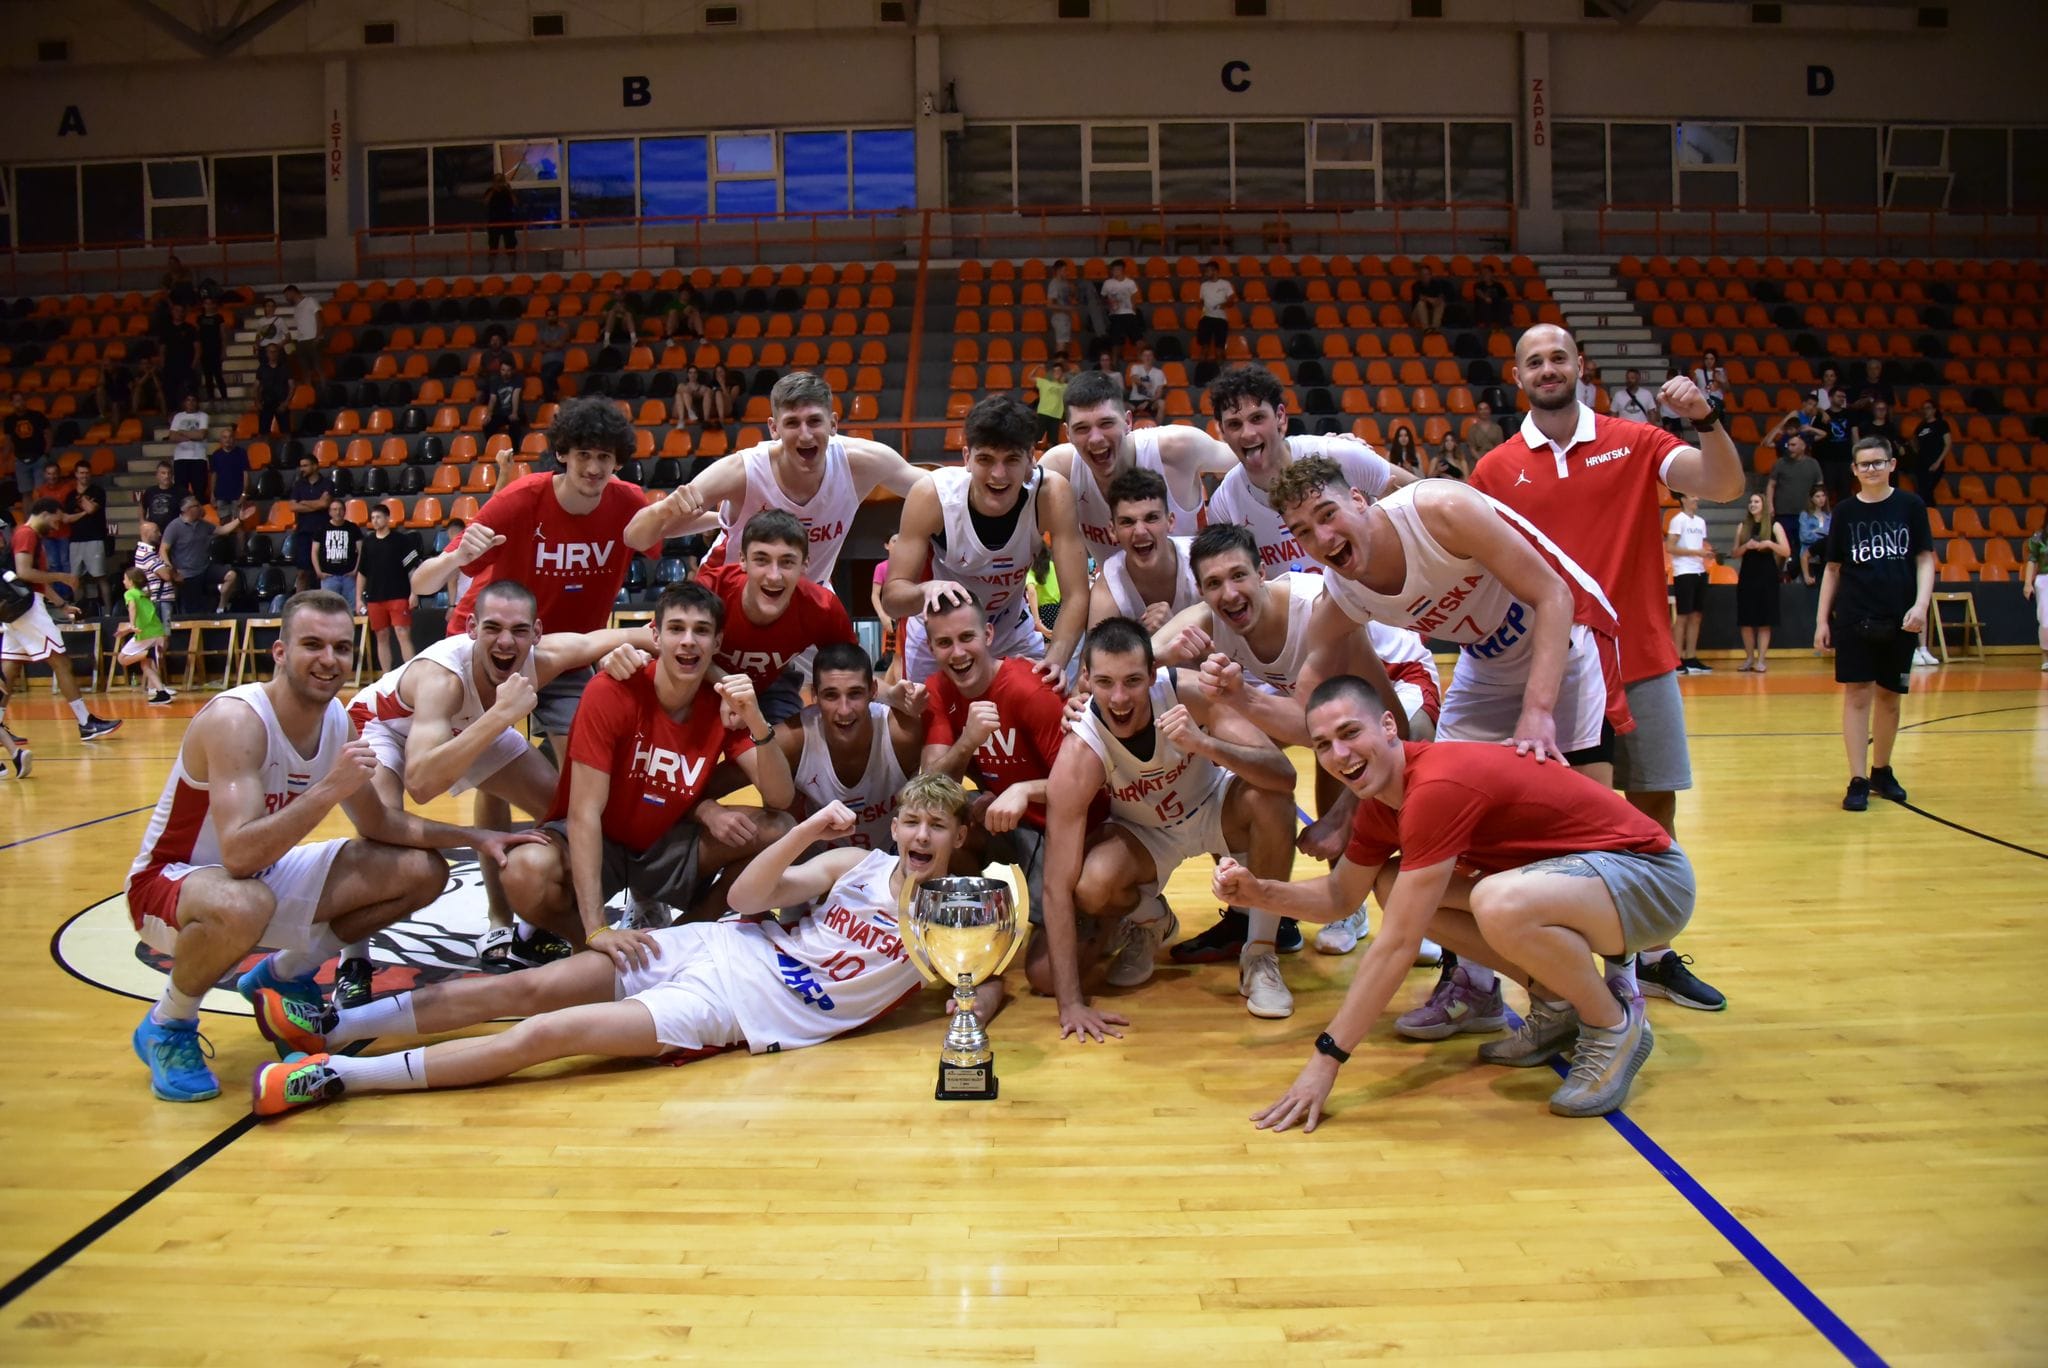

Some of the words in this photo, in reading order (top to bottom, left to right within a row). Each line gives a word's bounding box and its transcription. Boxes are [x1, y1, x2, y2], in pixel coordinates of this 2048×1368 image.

[622, 76, 652, 107] B
[1221, 61, 1251, 92] C
[1807, 65, 1834, 97] D
[58, 106, 87, 136] A
[1532, 79, 1544, 146] ZAPAD
[331, 109, 341, 176] ISTOK
[1585, 446, 1631, 467] HRVATSKA
[326, 530, 349, 540] NEVER
[326, 549, 348, 560] DOWN
[536, 540, 615, 570] HRV
[985, 591, 1010, 611] 2
[1451, 615, 1484, 636] 7
[632, 741, 706, 787] HRV
[1113, 752, 1195, 802] HRVATSKA
[1155, 791, 1184, 822] 15
[820, 950, 866, 982] 10
